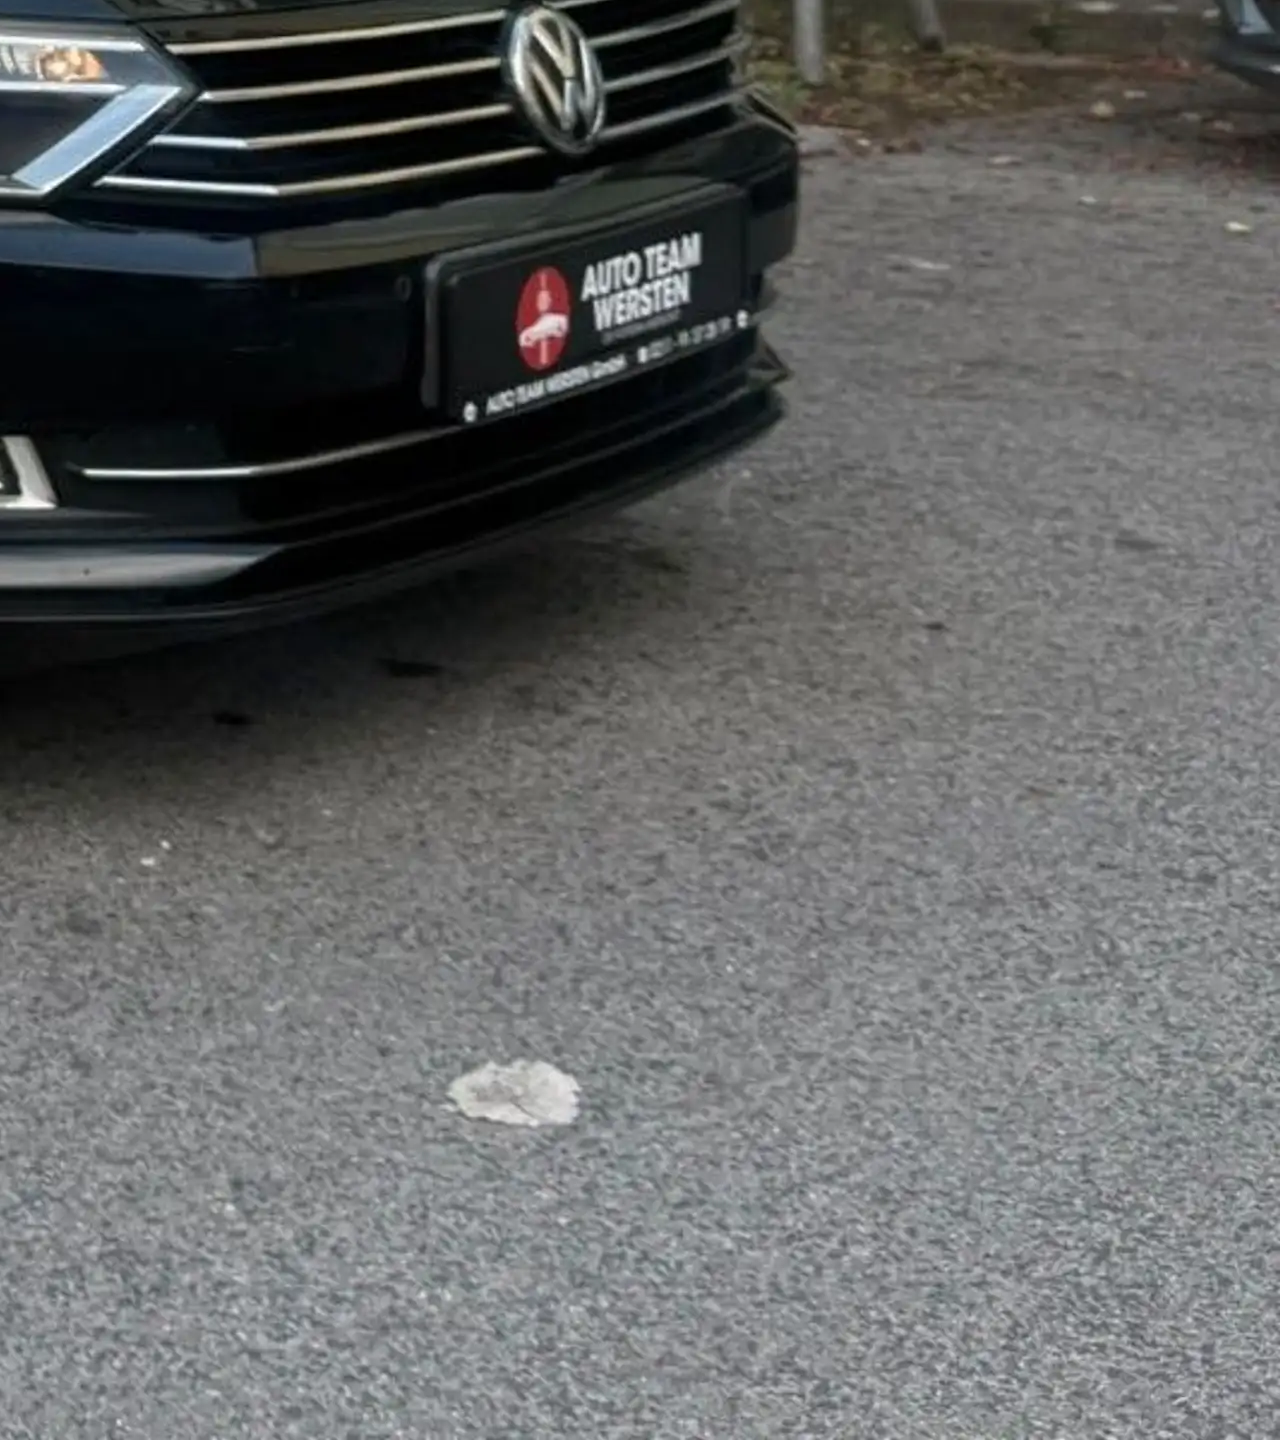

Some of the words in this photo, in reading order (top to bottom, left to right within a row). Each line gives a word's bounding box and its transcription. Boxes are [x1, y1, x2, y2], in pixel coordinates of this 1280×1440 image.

[581, 252, 641, 301] AUTO
[643, 232, 702, 279] TEAM
[593, 271, 690, 331] WERSTEN
